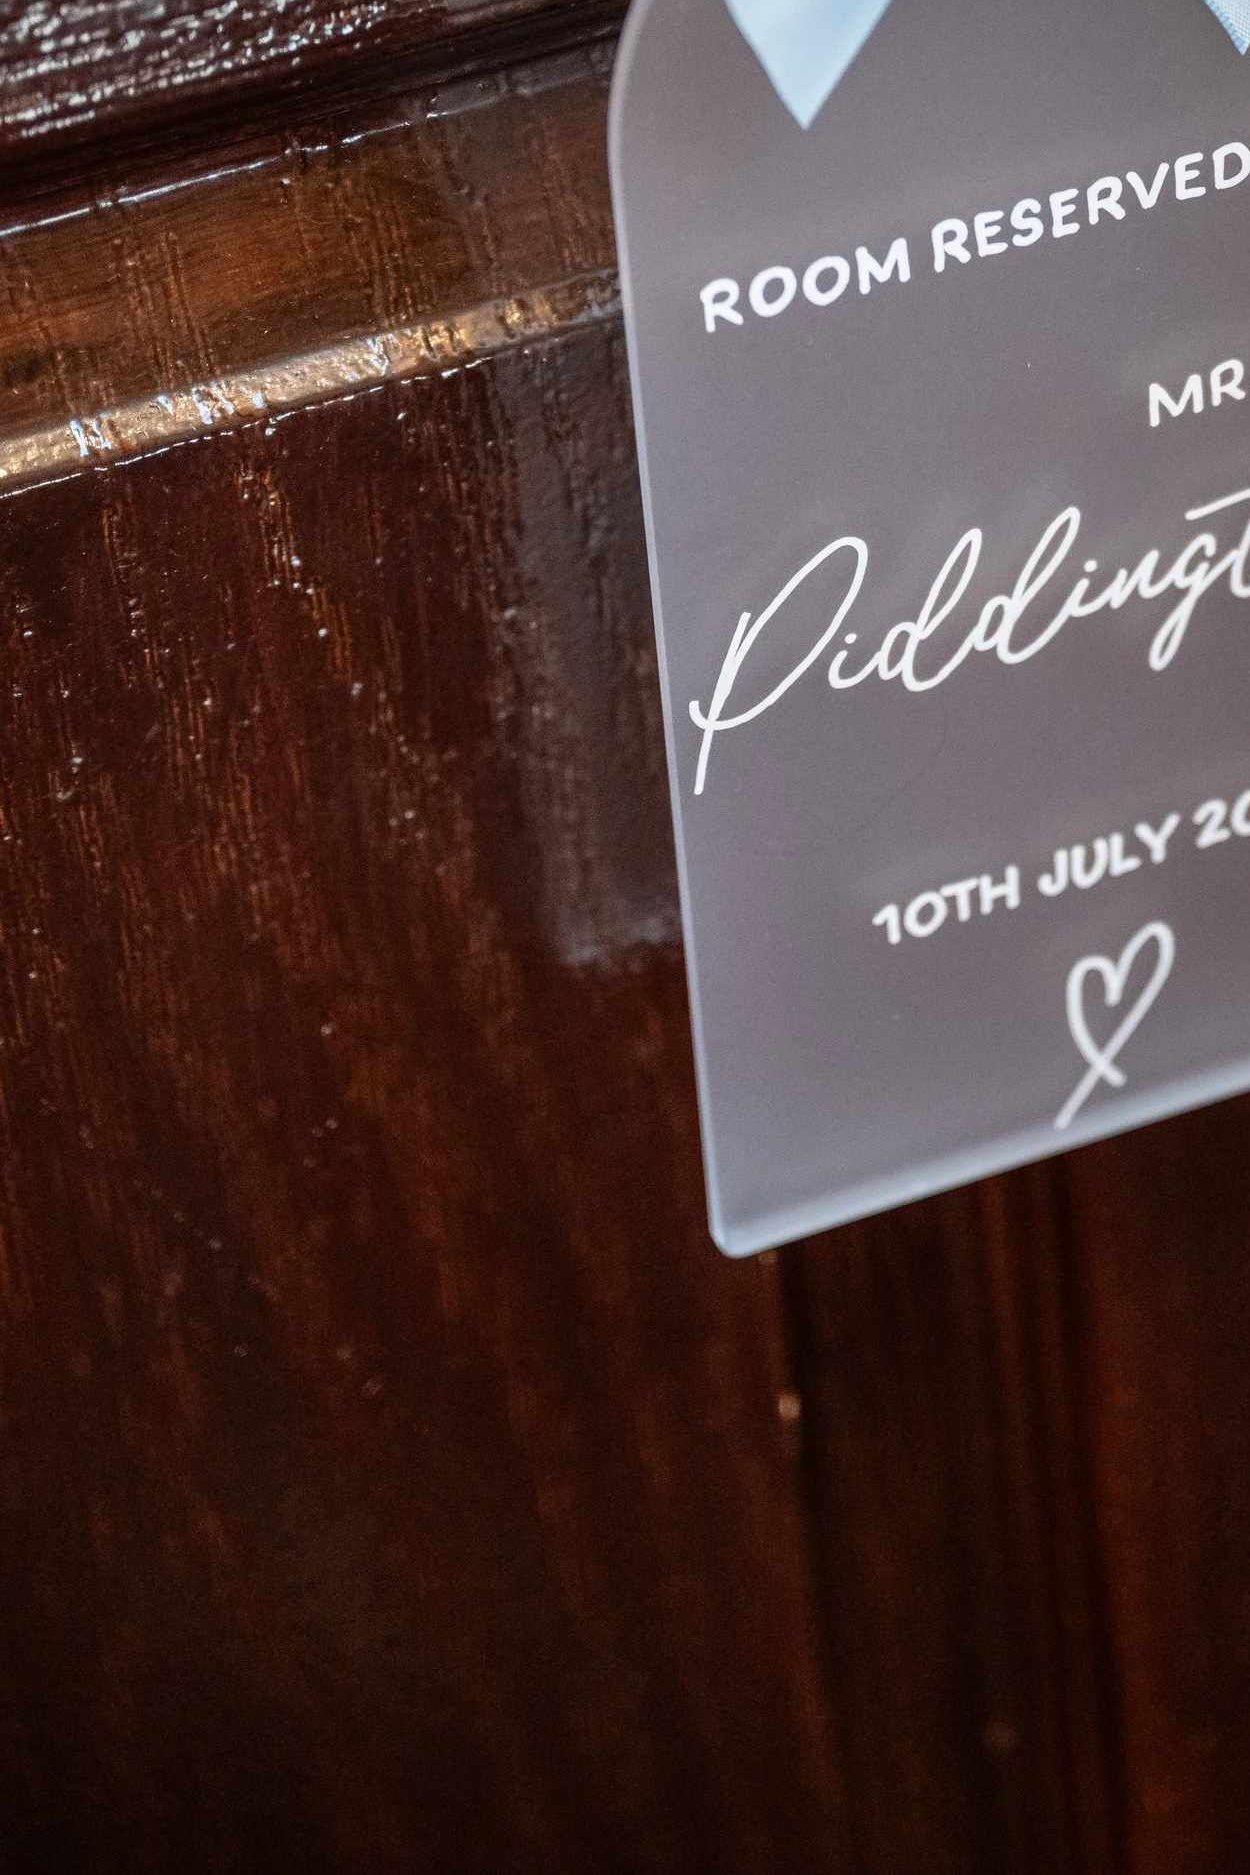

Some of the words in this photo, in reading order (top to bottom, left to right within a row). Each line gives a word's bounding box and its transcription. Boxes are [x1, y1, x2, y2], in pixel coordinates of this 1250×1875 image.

[698, 237, 912, 334] ROOM
[1146, 357, 1248, 429] MR
[870, 863, 1022, 946] 10TH
[1036, 811, 1182, 898] JULY
